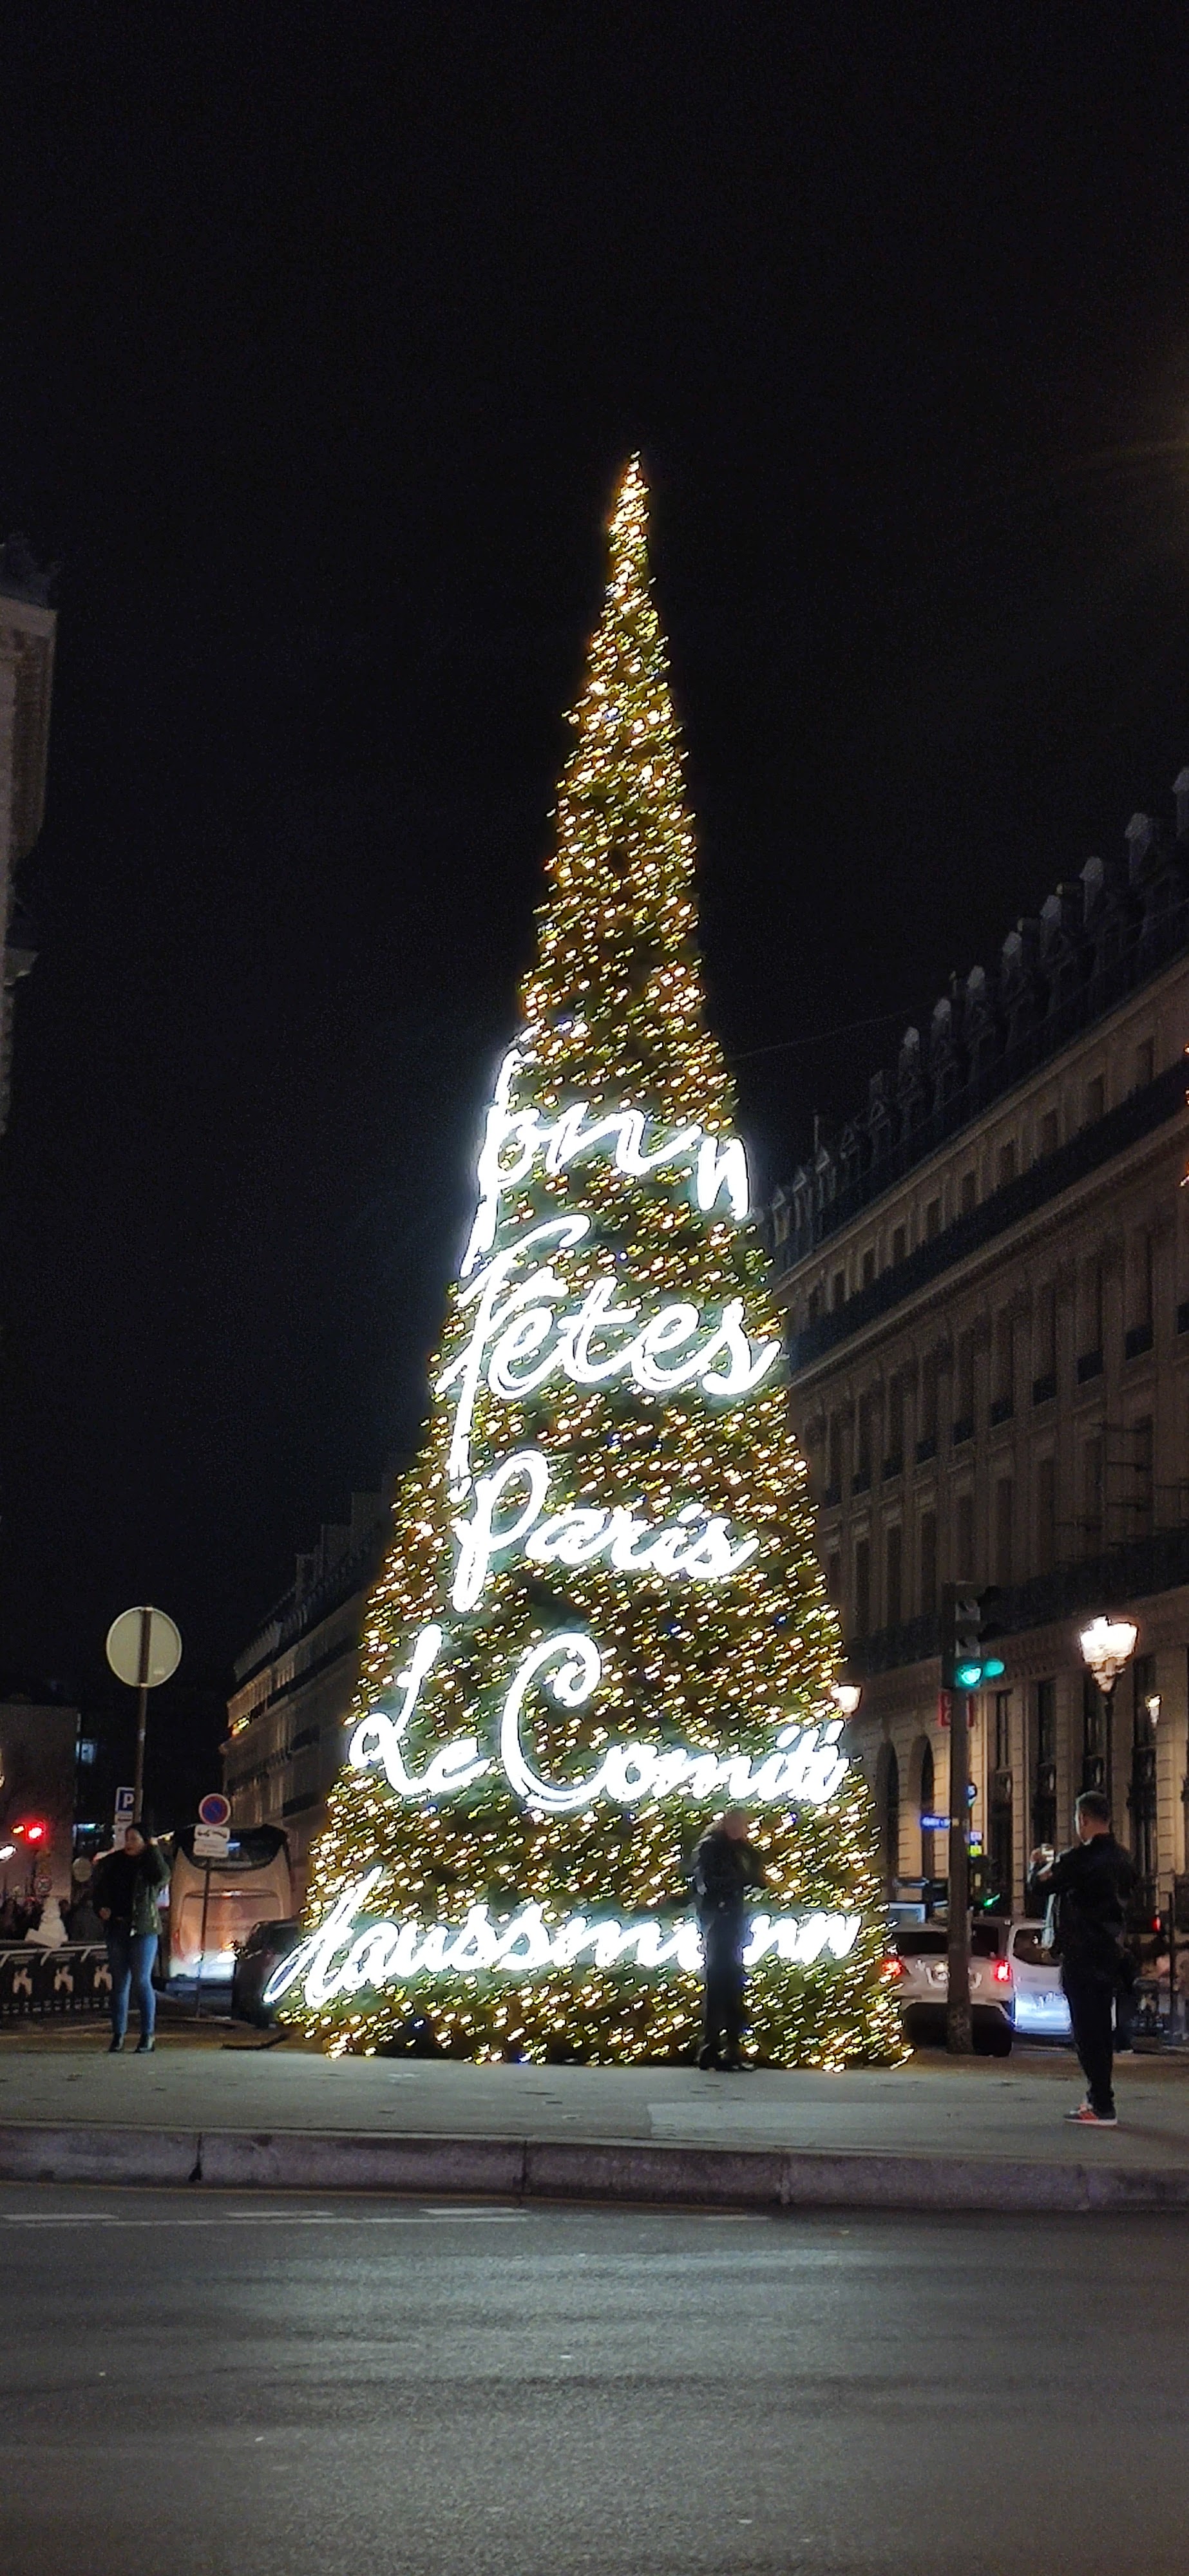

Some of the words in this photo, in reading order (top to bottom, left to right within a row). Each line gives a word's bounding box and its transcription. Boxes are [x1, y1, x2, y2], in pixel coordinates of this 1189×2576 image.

[452, 1450, 760, 1612] Paris
[348, 1622, 490, 1795] Le
[122, 1793, 135, 1808] P
